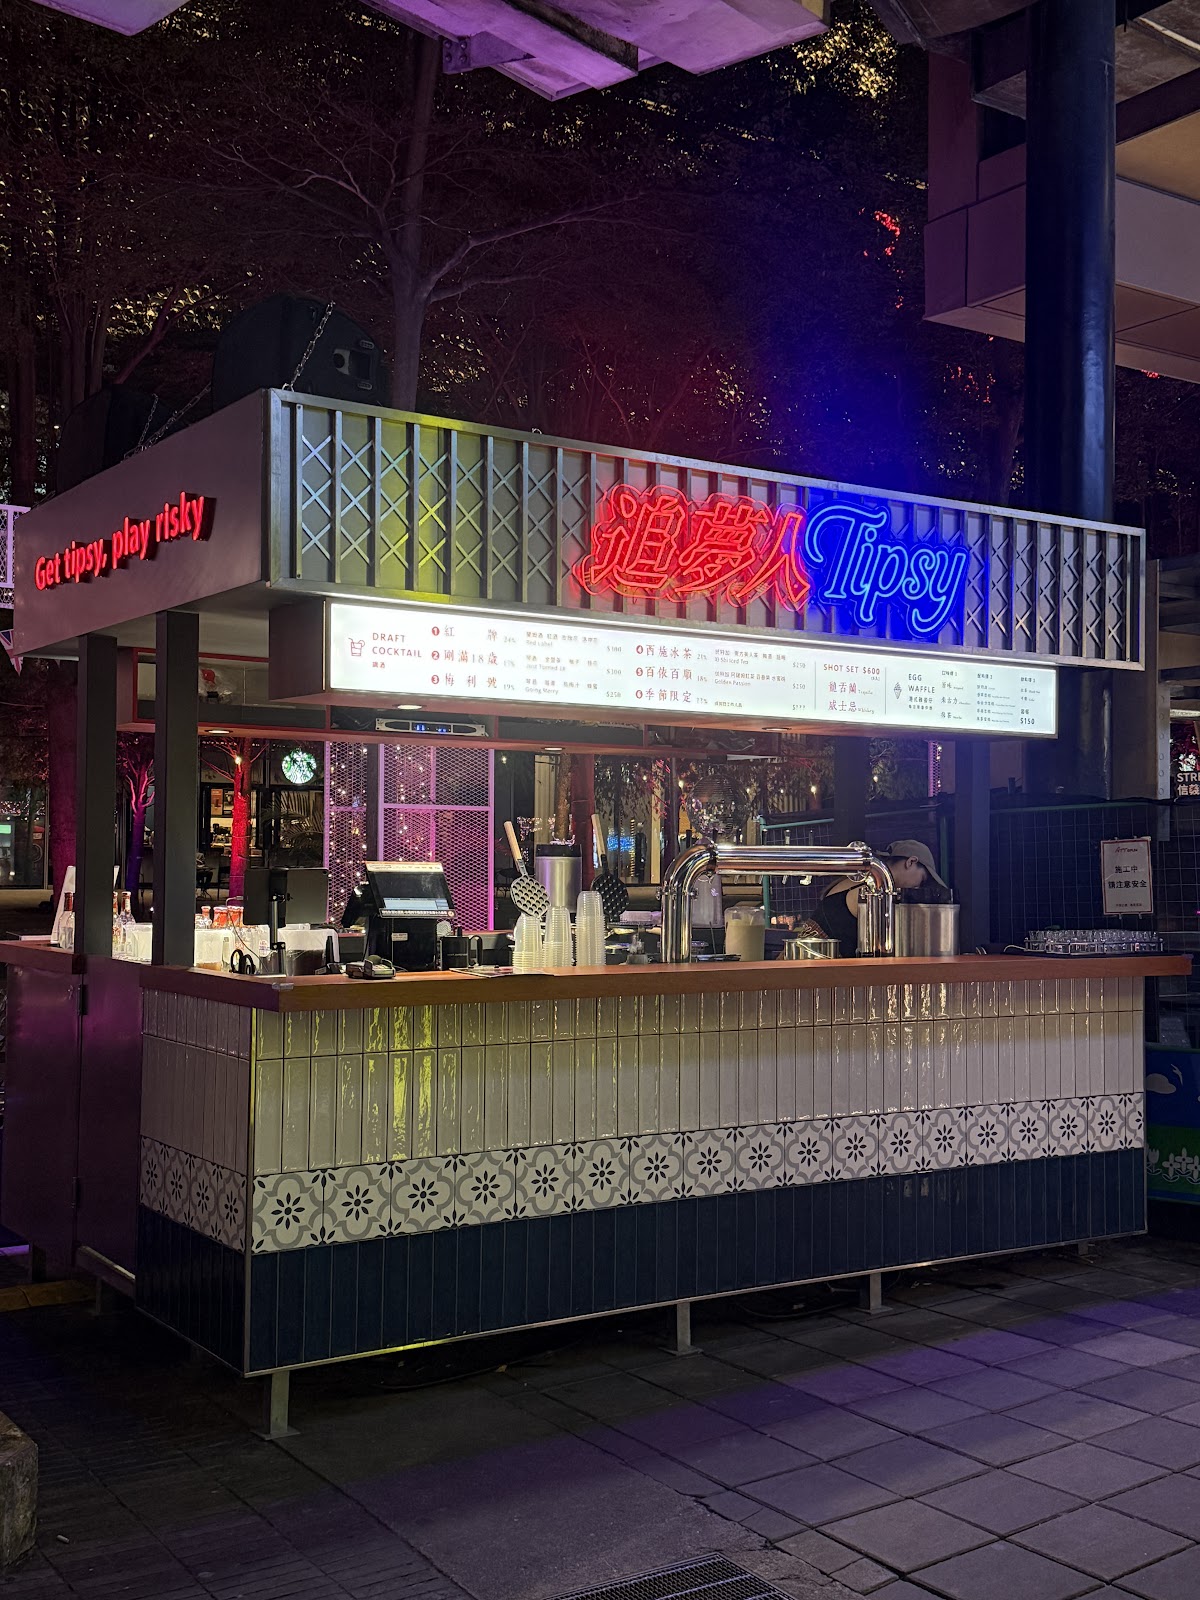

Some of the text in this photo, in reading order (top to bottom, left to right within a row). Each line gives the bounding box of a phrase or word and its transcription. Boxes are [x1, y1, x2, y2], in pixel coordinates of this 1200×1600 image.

[35, 491, 204, 591] Get tipsy, play risky
[587, 490, 811, 605] 追夢人
[804, 503, 966, 633] Tipsy
[372, 632, 406, 643] DRAFT
[371, 646, 422, 658] COCKTAIL
[645, 644, 692, 660] 西施冰茶
[645, 666, 693, 681] 百依百順
[823, 663, 880, 675] SHOT SET $600
[431, 674, 440, 685] 3
[908, 673, 922, 681] EGG
[645, 687, 692, 703] 季節限定
[907, 684, 935, 694] WAFFLE
[828, 700, 857, 713] 威士忌
[1177, 784, 1200, 796] 信義
[1115, 865, 1138, 873] 施工中
[1108, 880, 1147, 889] 請注意安全
